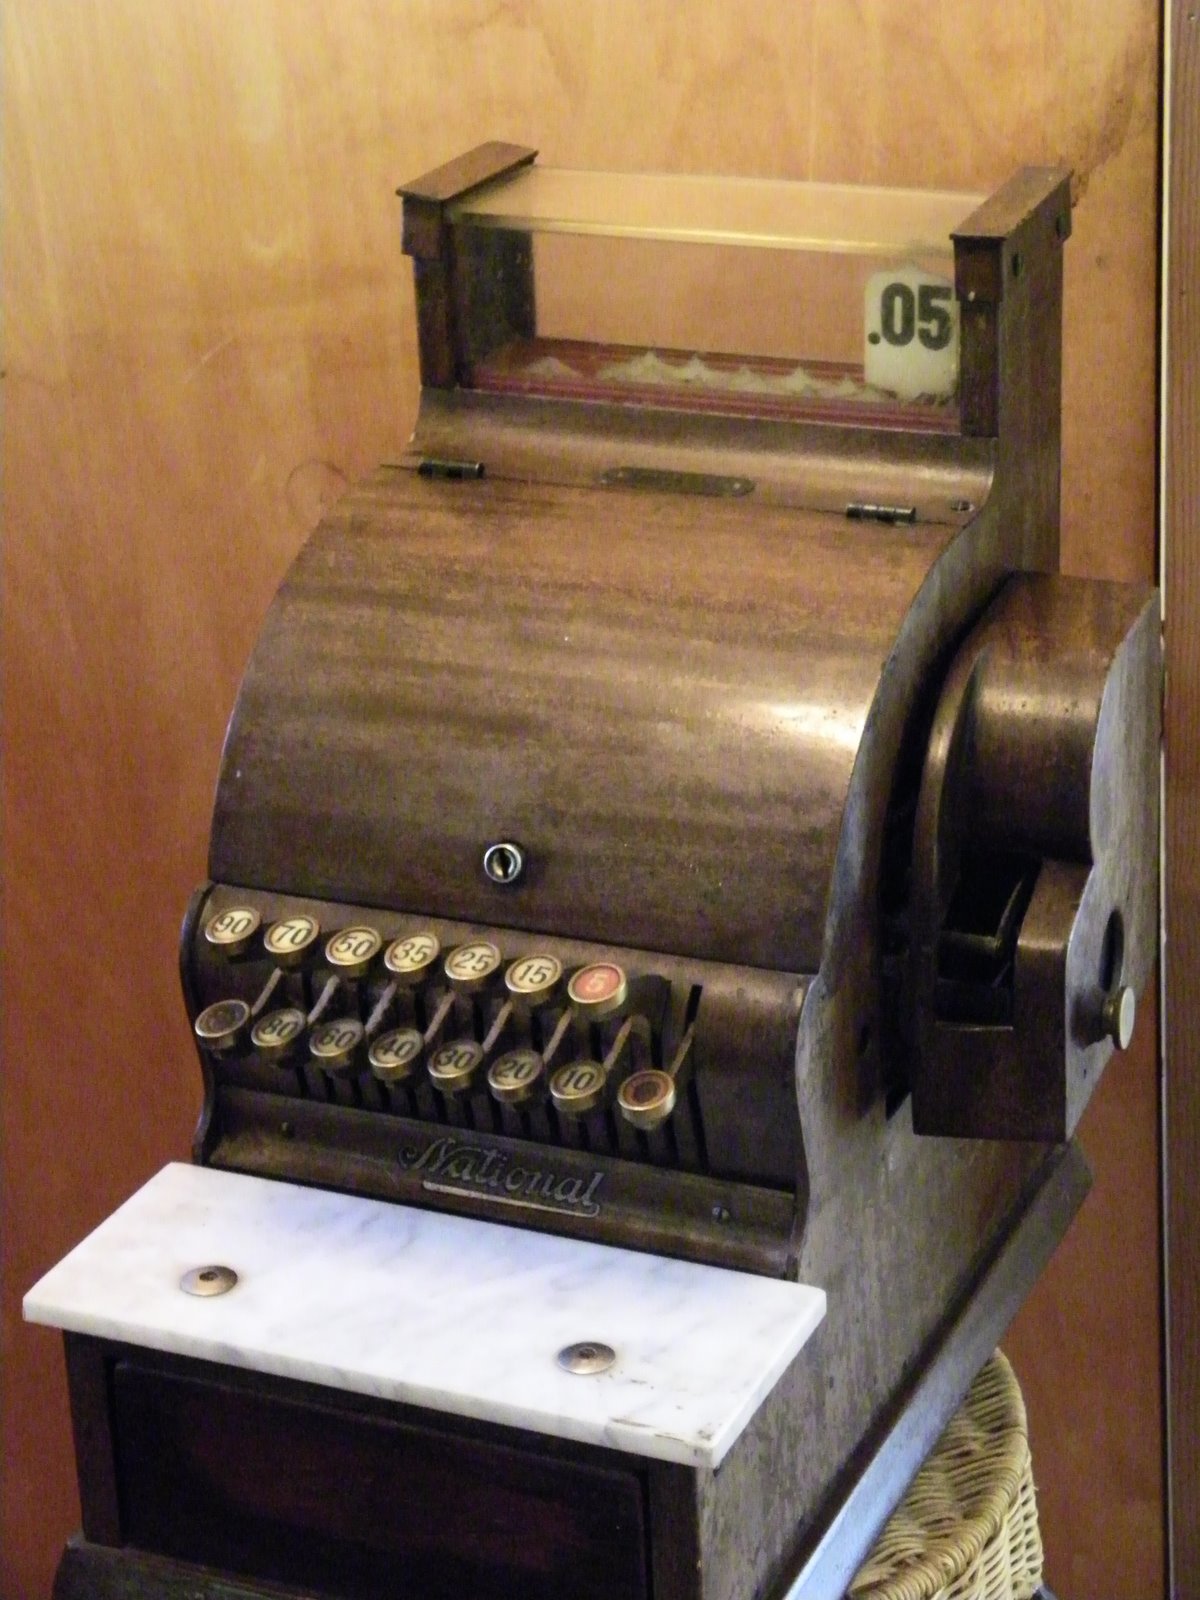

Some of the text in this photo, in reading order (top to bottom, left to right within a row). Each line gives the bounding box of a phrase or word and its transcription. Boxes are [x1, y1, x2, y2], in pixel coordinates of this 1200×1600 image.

[867, 282, 954, 351] .05
[214, 915, 252, 934] 90
[275, 924, 312, 945] 70
[335, 936, 374, 957] 50
[394, 942, 430, 964] 35
[454, 951, 493, 972] 25
[519, 963, 552, 985] 15
[587, 972, 608, 992] 5
[263, 1018, 297, 1037] 80
[322, 1029, 357, 1048] 60
[381, 1039, 417, 1059] 40
[437, 1051, 475, 1070] 30
[500, 1060, 534, 1080] 20
[561, 1071, 595, 1090] 10
[399, 1137, 605, 1208] National
